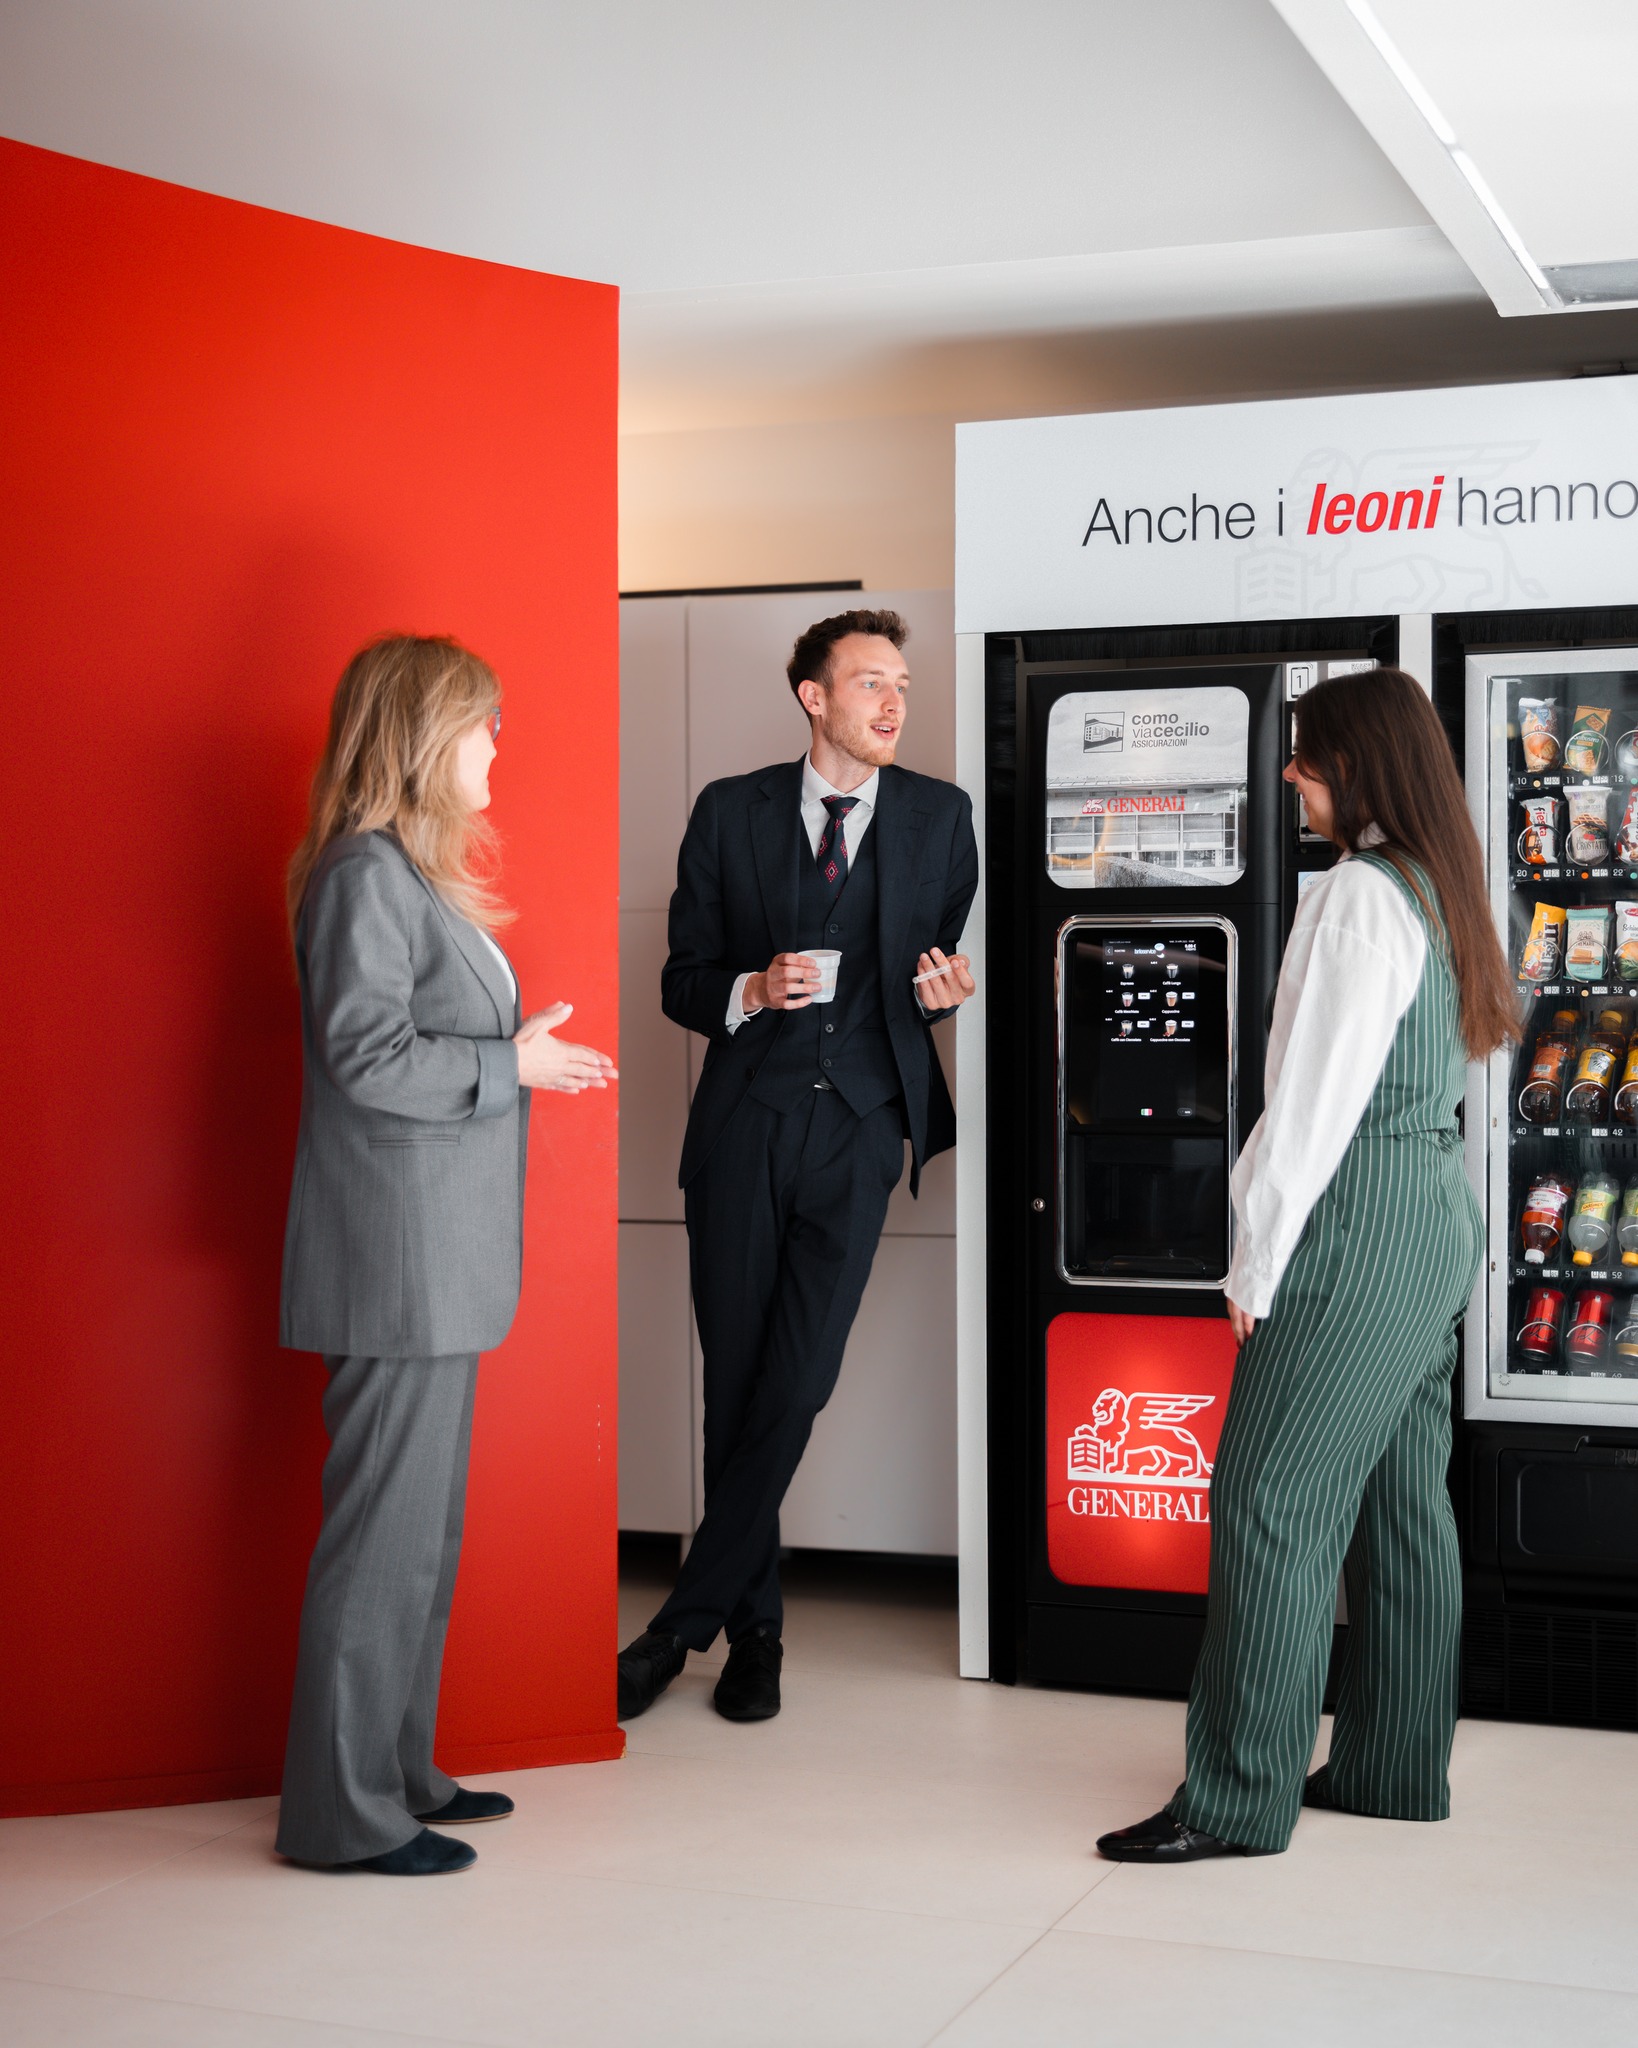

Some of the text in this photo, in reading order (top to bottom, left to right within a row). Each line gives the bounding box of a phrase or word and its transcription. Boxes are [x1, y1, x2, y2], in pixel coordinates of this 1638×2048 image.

[1082, 475, 1638, 546] Anche i leoni hanno
[1296, 670, 1302, 689] 1
[1131, 713, 1179, 726] como
[1131, 738, 1188, 748] ASSICURAZIONI
[1517, 777, 1527, 785] 10
[1566, 776, 1575, 784] 11
[1614, 775, 1624, 783] 12
[1107, 795, 1185, 813] GENERALI
[1516, 869, 1527, 877] 20
[1566, 869, 1575, 877] 21
[1613, 869, 1624, 877] 22
[1517, 986, 1527, 994] 30
[1566, 986, 1575, 994] 31
[1613, 986, 1624, 994] 32
[1516, 1127, 1527, 1135] 40
[1565, 1128, 1575, 1136] 41
[1612, 1128, 1623, 1136] 42
[1516, 1268, 1526, 1276] 50
[1565, 1270, 1574, 1278] 51
[1612, 1271, 1622, 1279] 52
[1067, 1487, 1210, 1523] GENERAL
